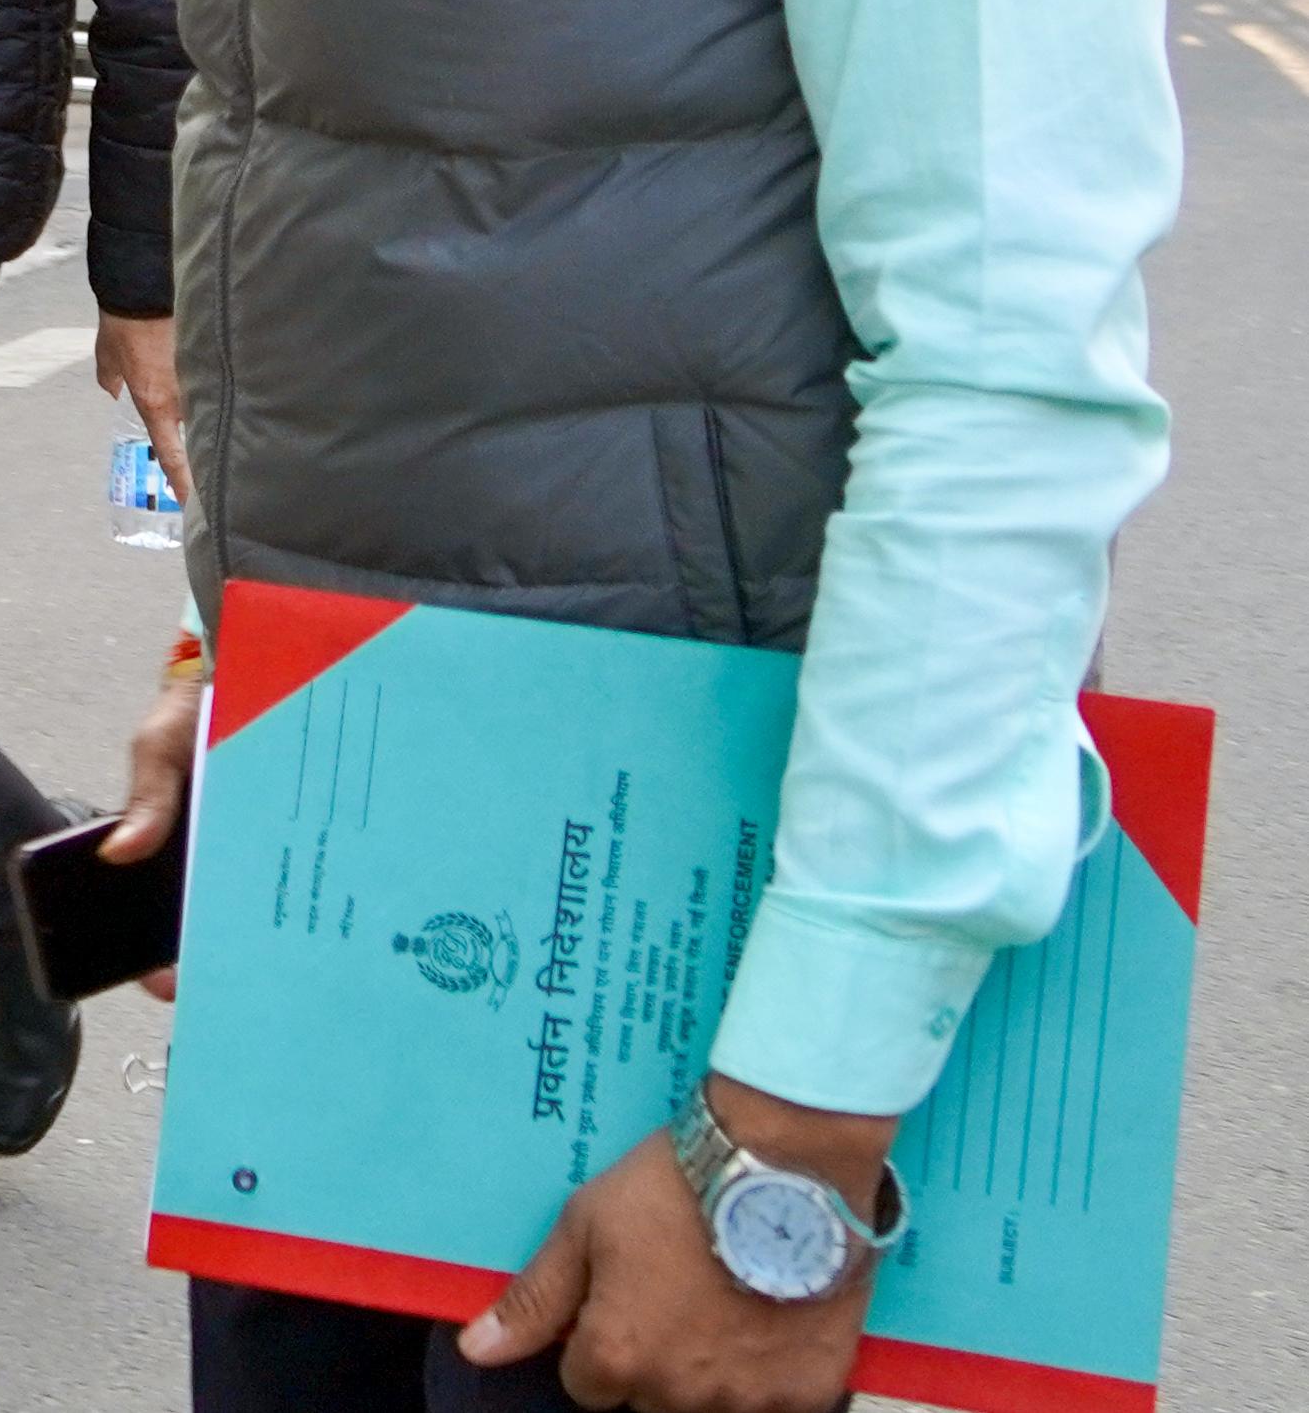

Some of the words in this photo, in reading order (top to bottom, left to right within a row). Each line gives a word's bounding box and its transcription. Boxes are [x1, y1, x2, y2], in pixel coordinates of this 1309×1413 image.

[609, 770, 629, 833] अधिनियम
[536, 819, 595, 997] निदेशालय
[725, 818, 759, 981] ENFORCEMENT
[528, 1013, 572, 1121] प्रवर्तन
